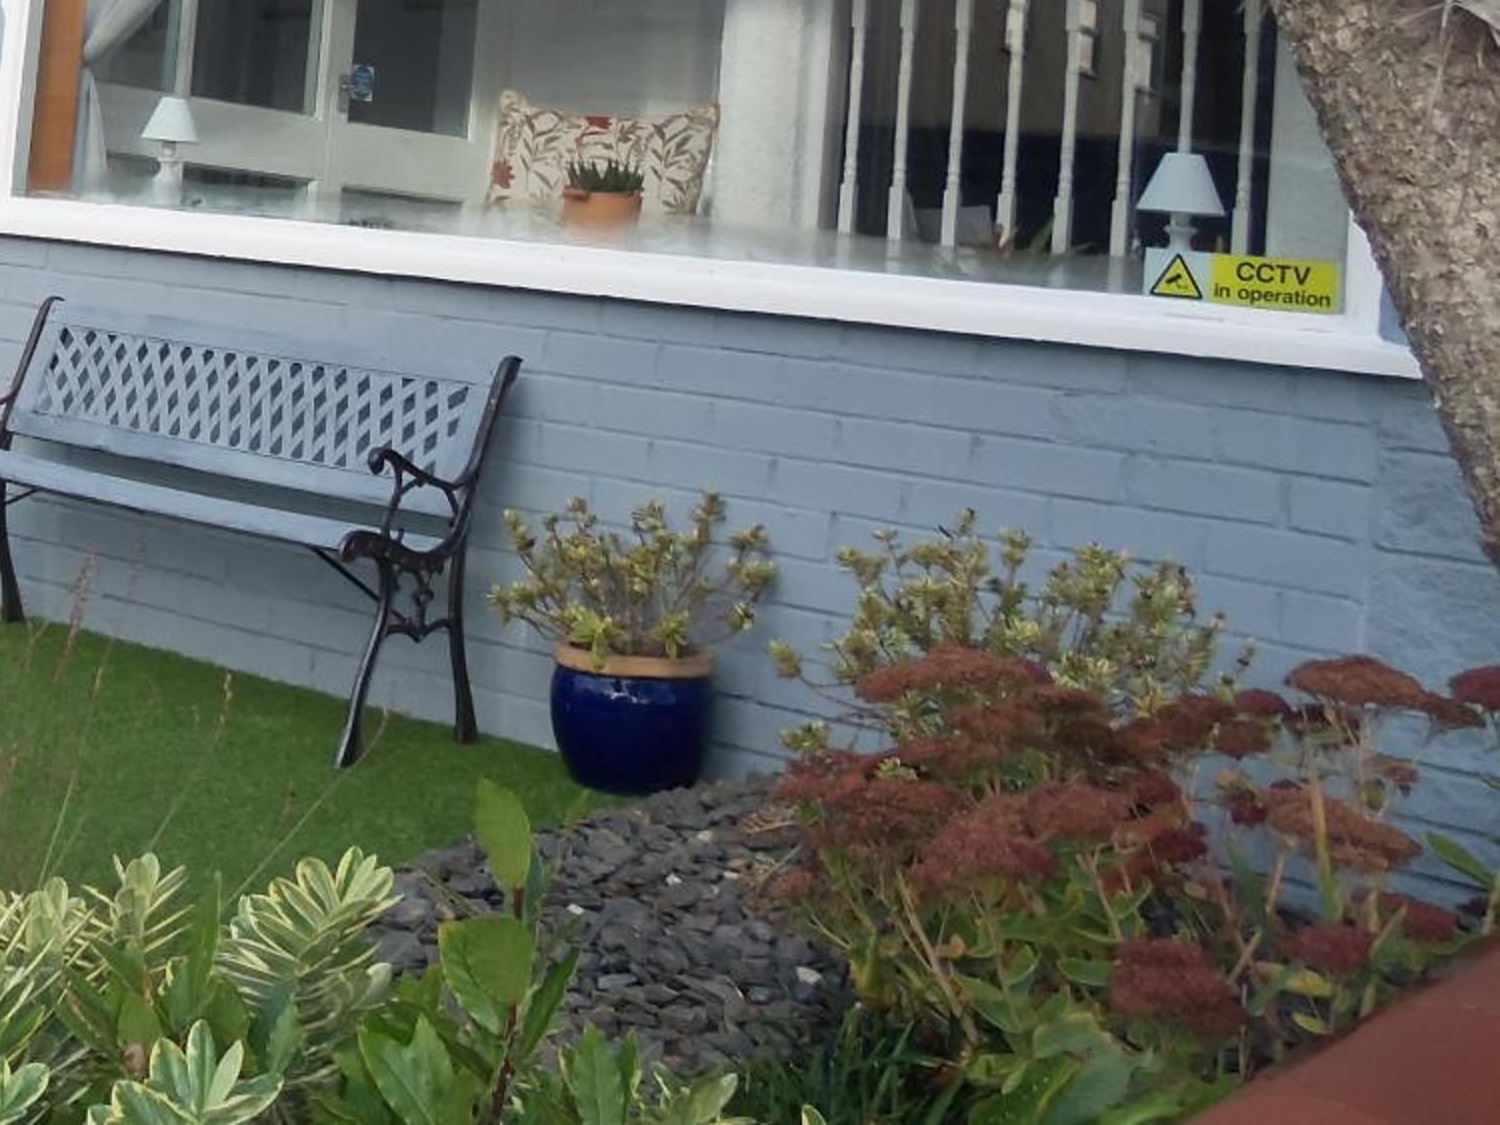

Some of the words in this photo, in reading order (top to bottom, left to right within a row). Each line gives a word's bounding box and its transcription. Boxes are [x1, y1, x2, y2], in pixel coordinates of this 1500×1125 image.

[1236, 262, 1312, 286] CCTV
[1213, 283, 1231, 298] in
[1237, 286, 1332, 308] operation
